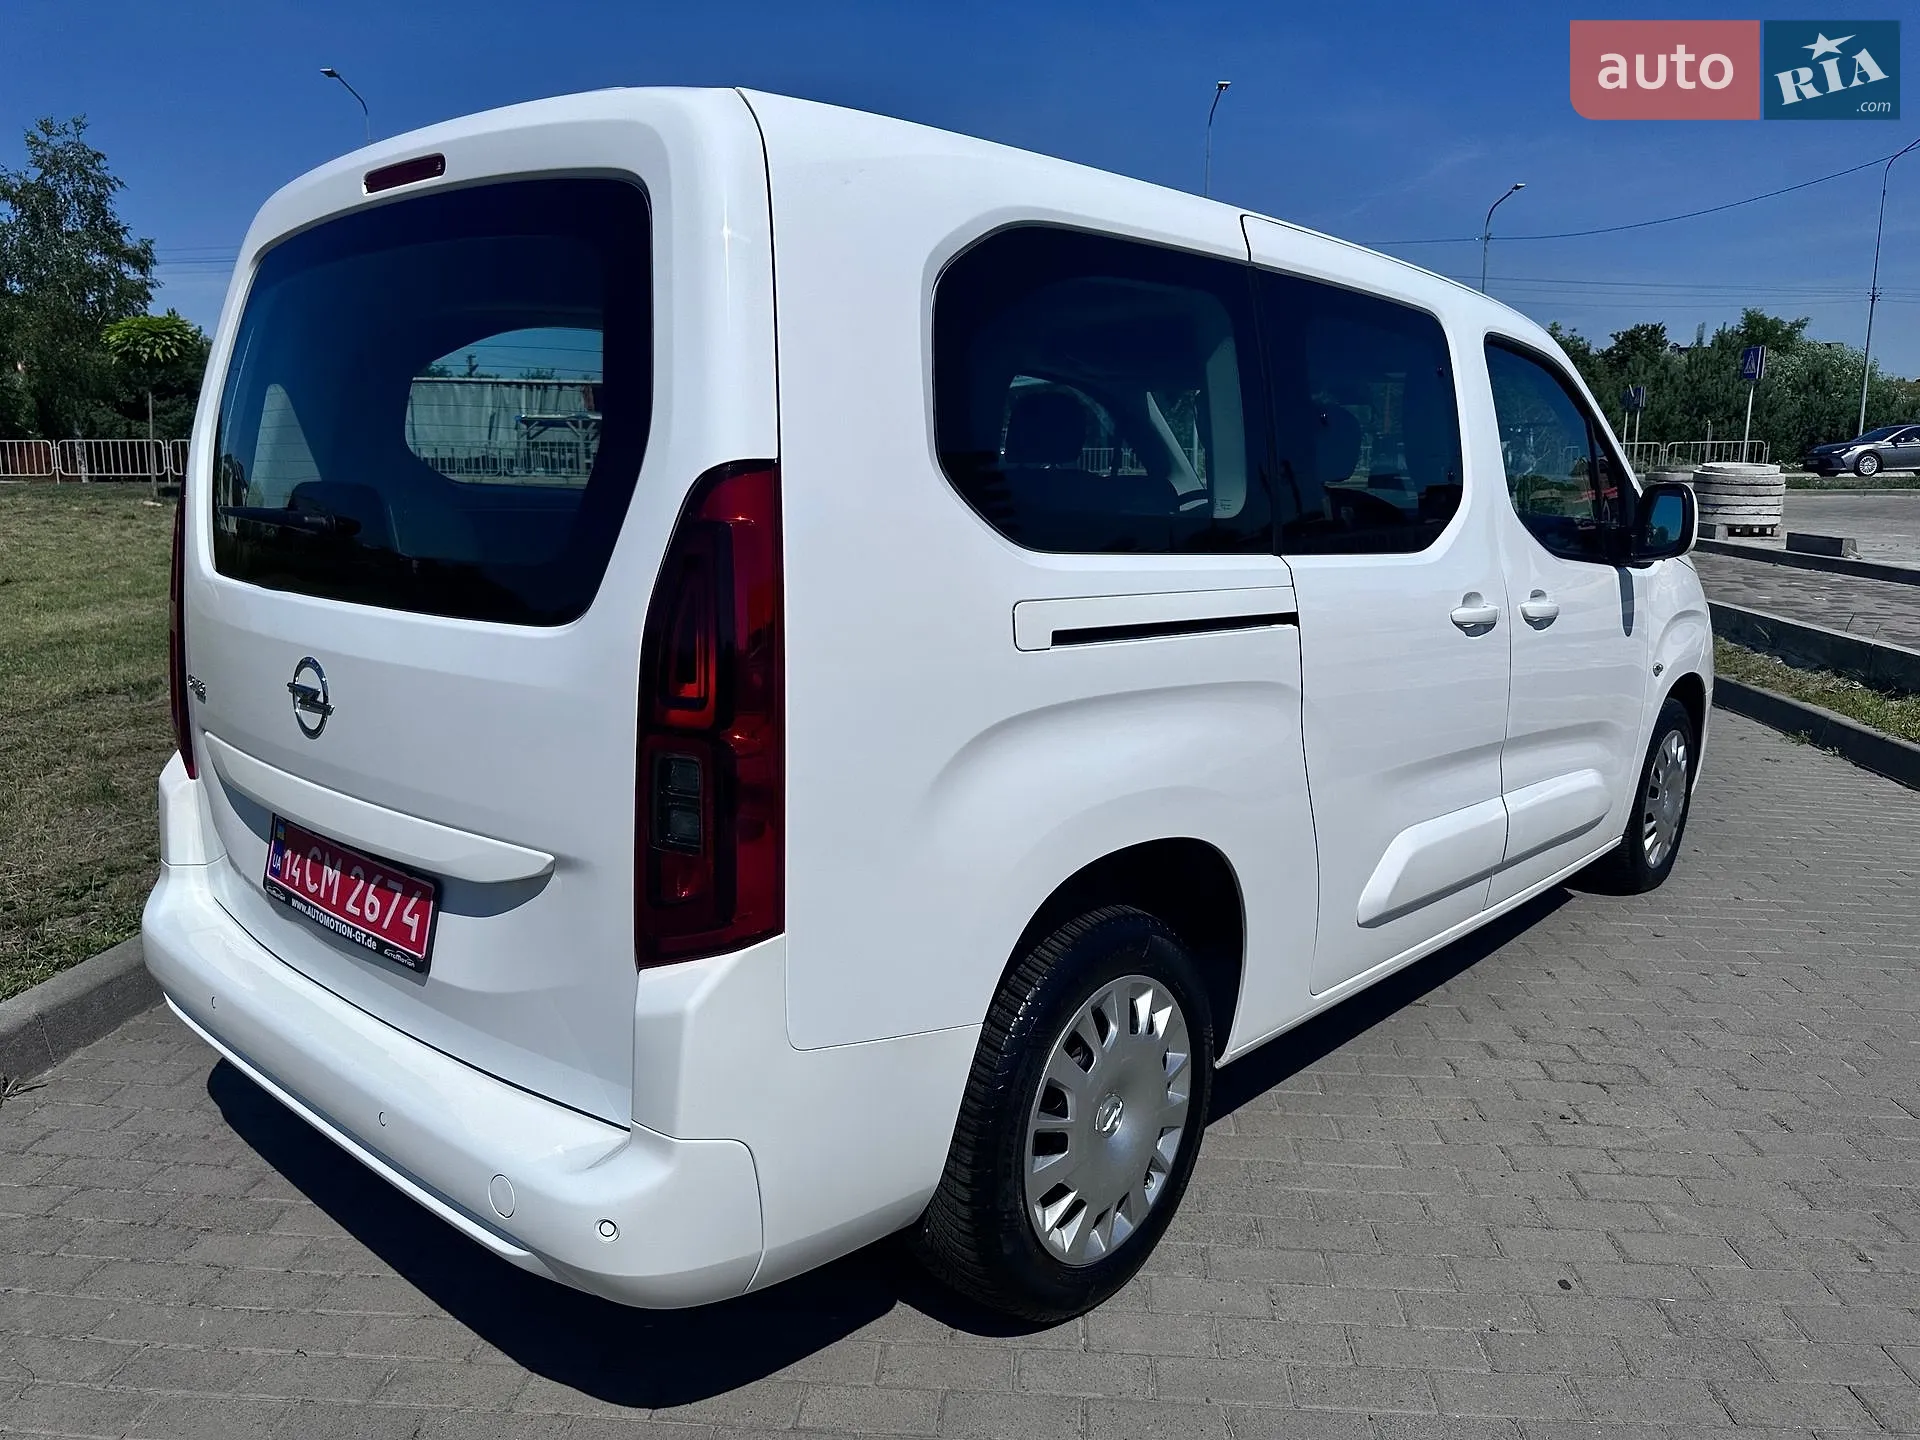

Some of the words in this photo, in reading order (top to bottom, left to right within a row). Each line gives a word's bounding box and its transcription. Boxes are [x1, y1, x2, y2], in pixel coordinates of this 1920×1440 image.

[272, 855, 281, 871] UA
[291, 897, 377, 951] www.AUTOMOTION-GT.de
[345, 865, 422, 942] 2674
